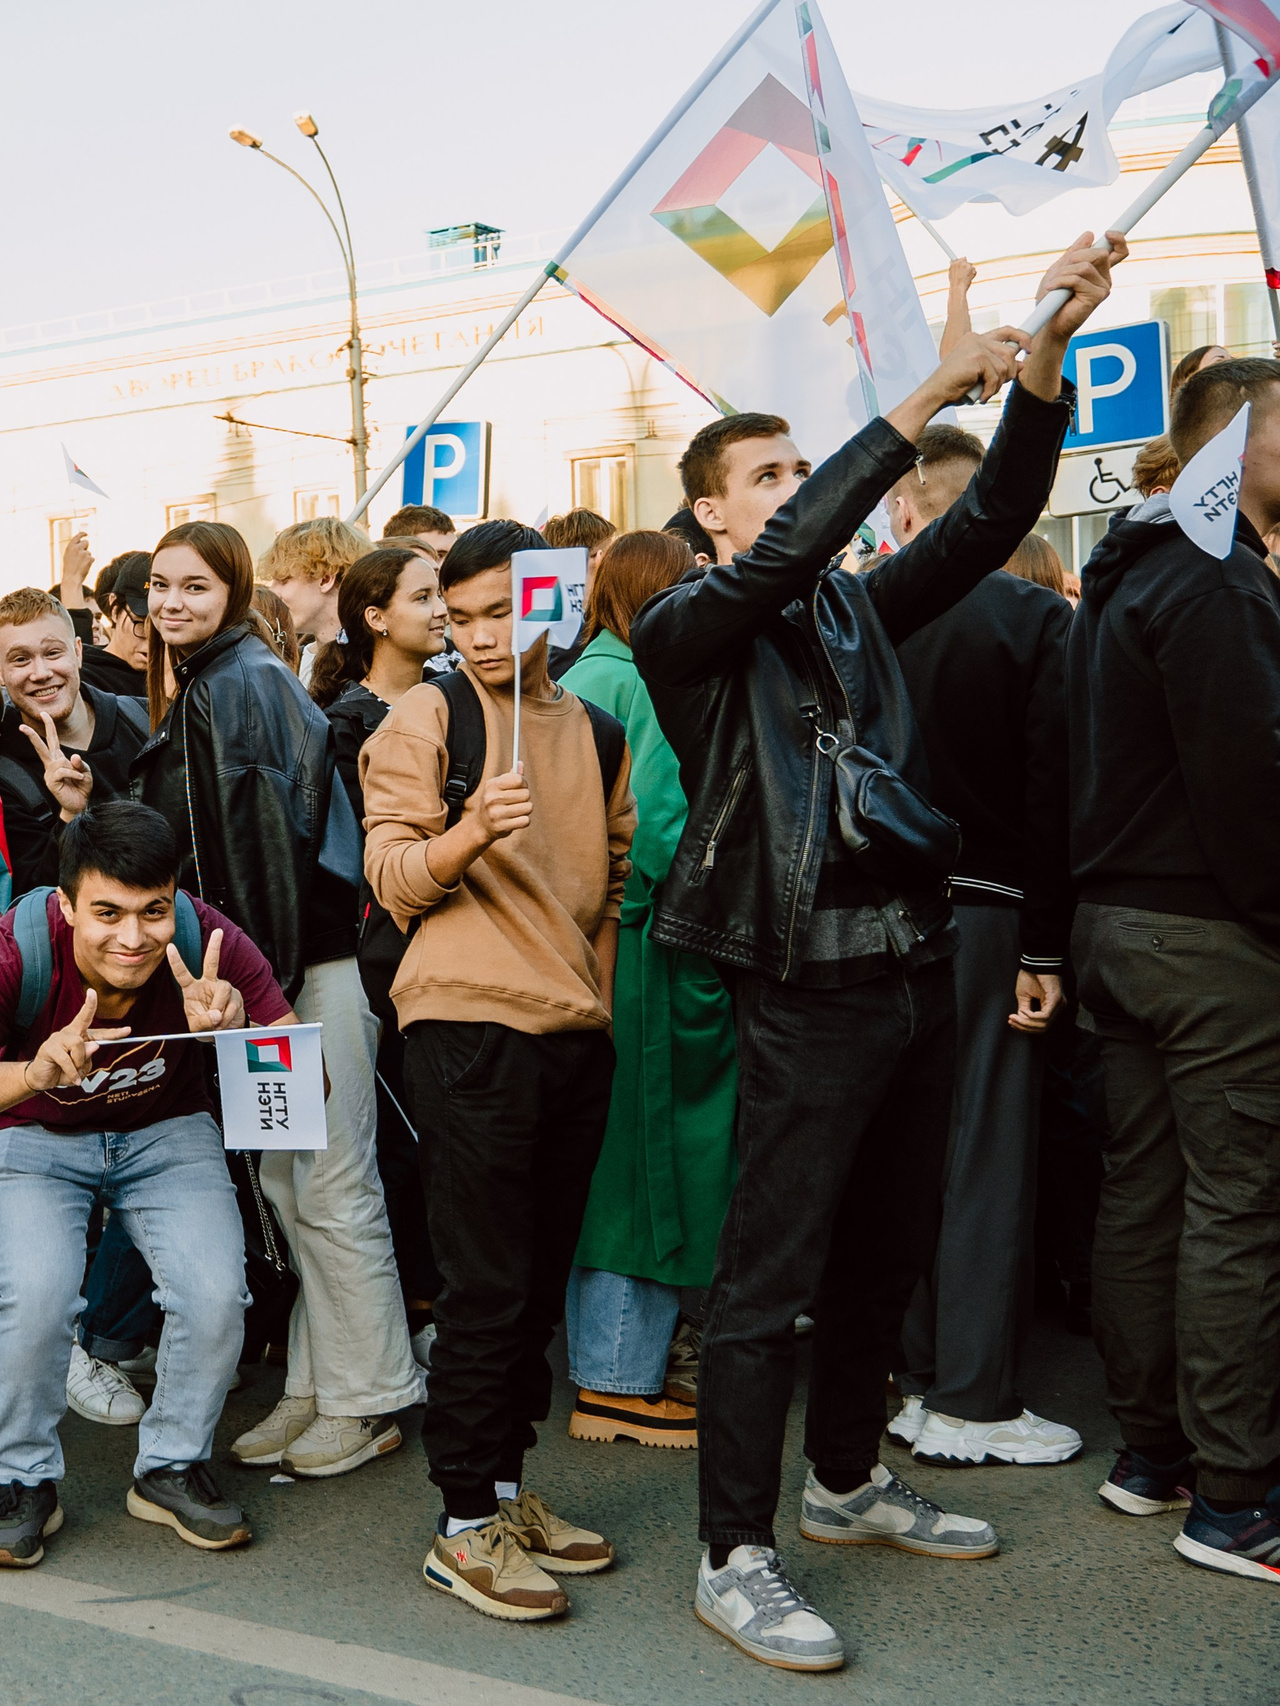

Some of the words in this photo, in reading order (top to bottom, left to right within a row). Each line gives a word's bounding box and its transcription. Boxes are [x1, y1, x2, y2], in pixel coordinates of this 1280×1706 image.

[108, 367, 222, 400] ДВОРЕЦ
[1075, 343, 1137, 434] P
[422, 433, 466, 507] P
[257, 1082, 273, 1130] НЭТИ
[273, 1082, 289, 1130] НГТУ
